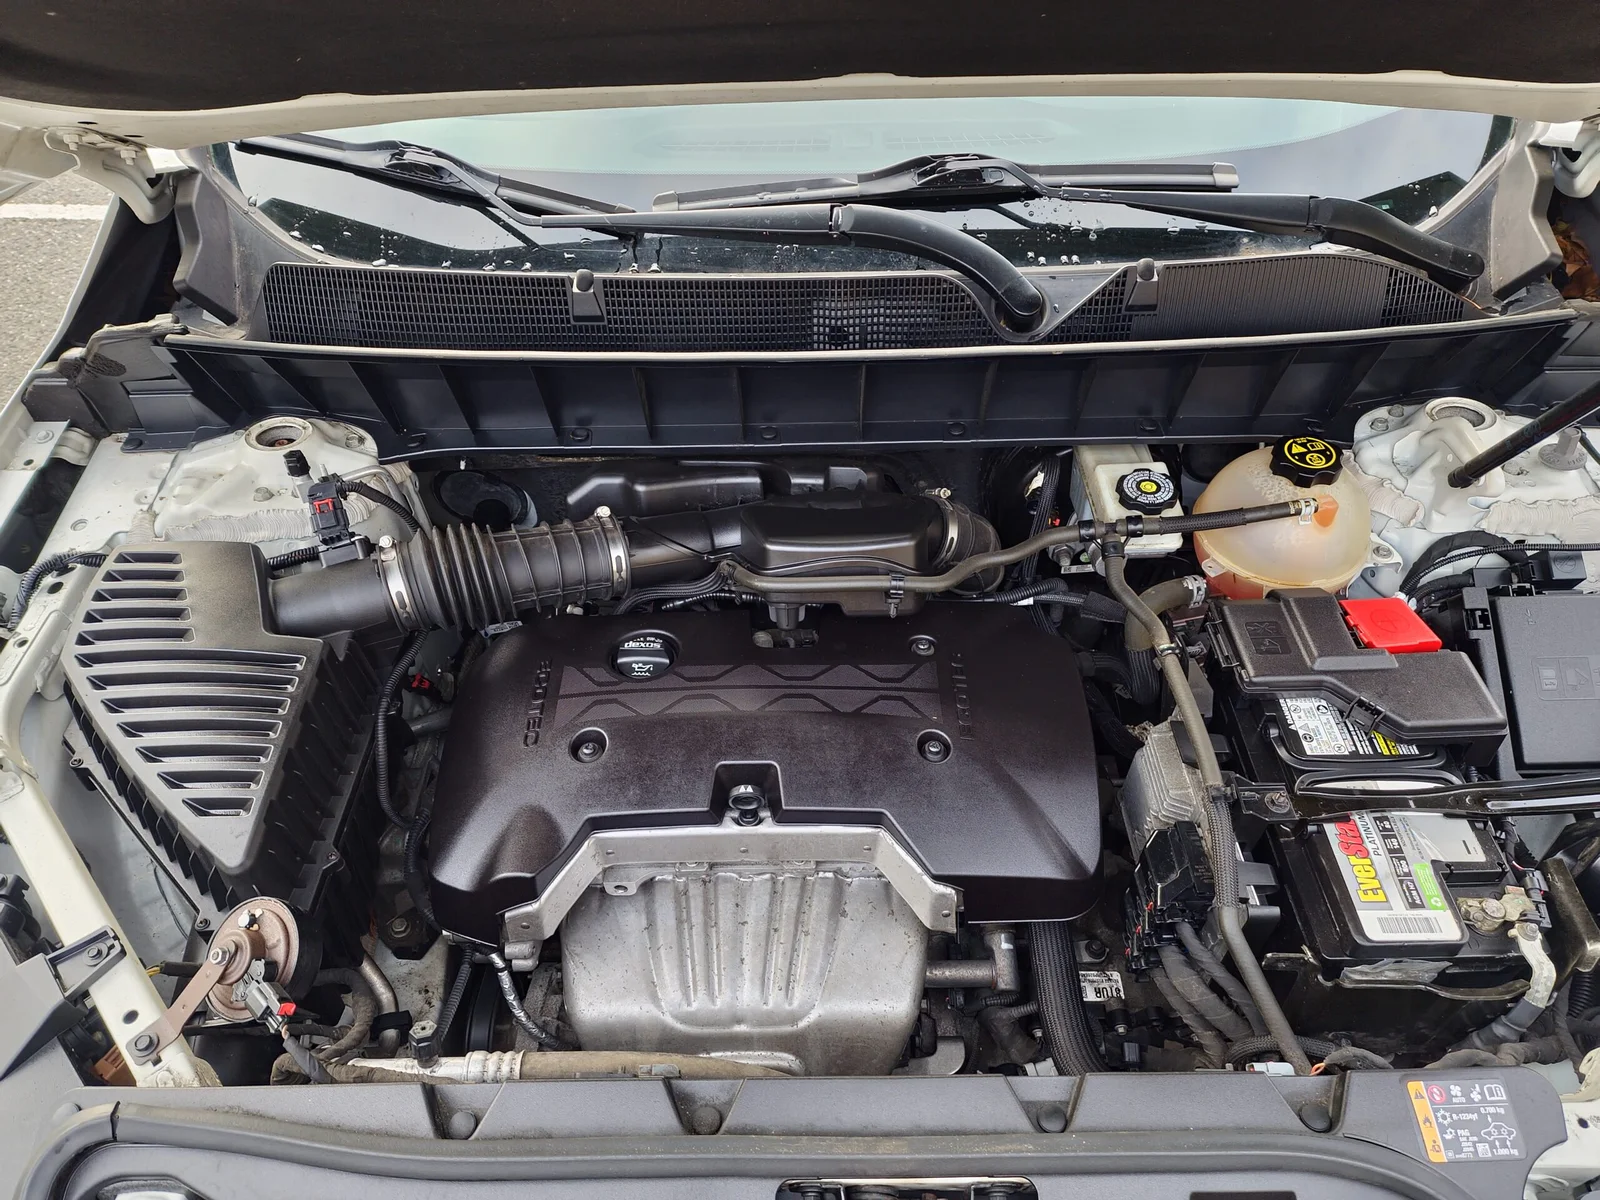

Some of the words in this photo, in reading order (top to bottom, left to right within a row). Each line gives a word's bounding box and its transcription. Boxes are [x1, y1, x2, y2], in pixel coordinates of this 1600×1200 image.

[523, 659, 552, 748] ECOTEC
[1280, 699, 1293, 724] DANGER
[1335, 812, 1388, 903] EverSta
[1410, 890, 1422, 904] AGM
[1480, 1106, 1497, 1114] 0.700
[1496, 1106, 1505, 1115] kg
[1452, 1113, 1478, 1121] R-1234yf
[1457, 1129, 1470, 1137] PAG
[1492, 1148, 1510, 1156] 1.000
[1509, 1148, 1519, 1156] kg
